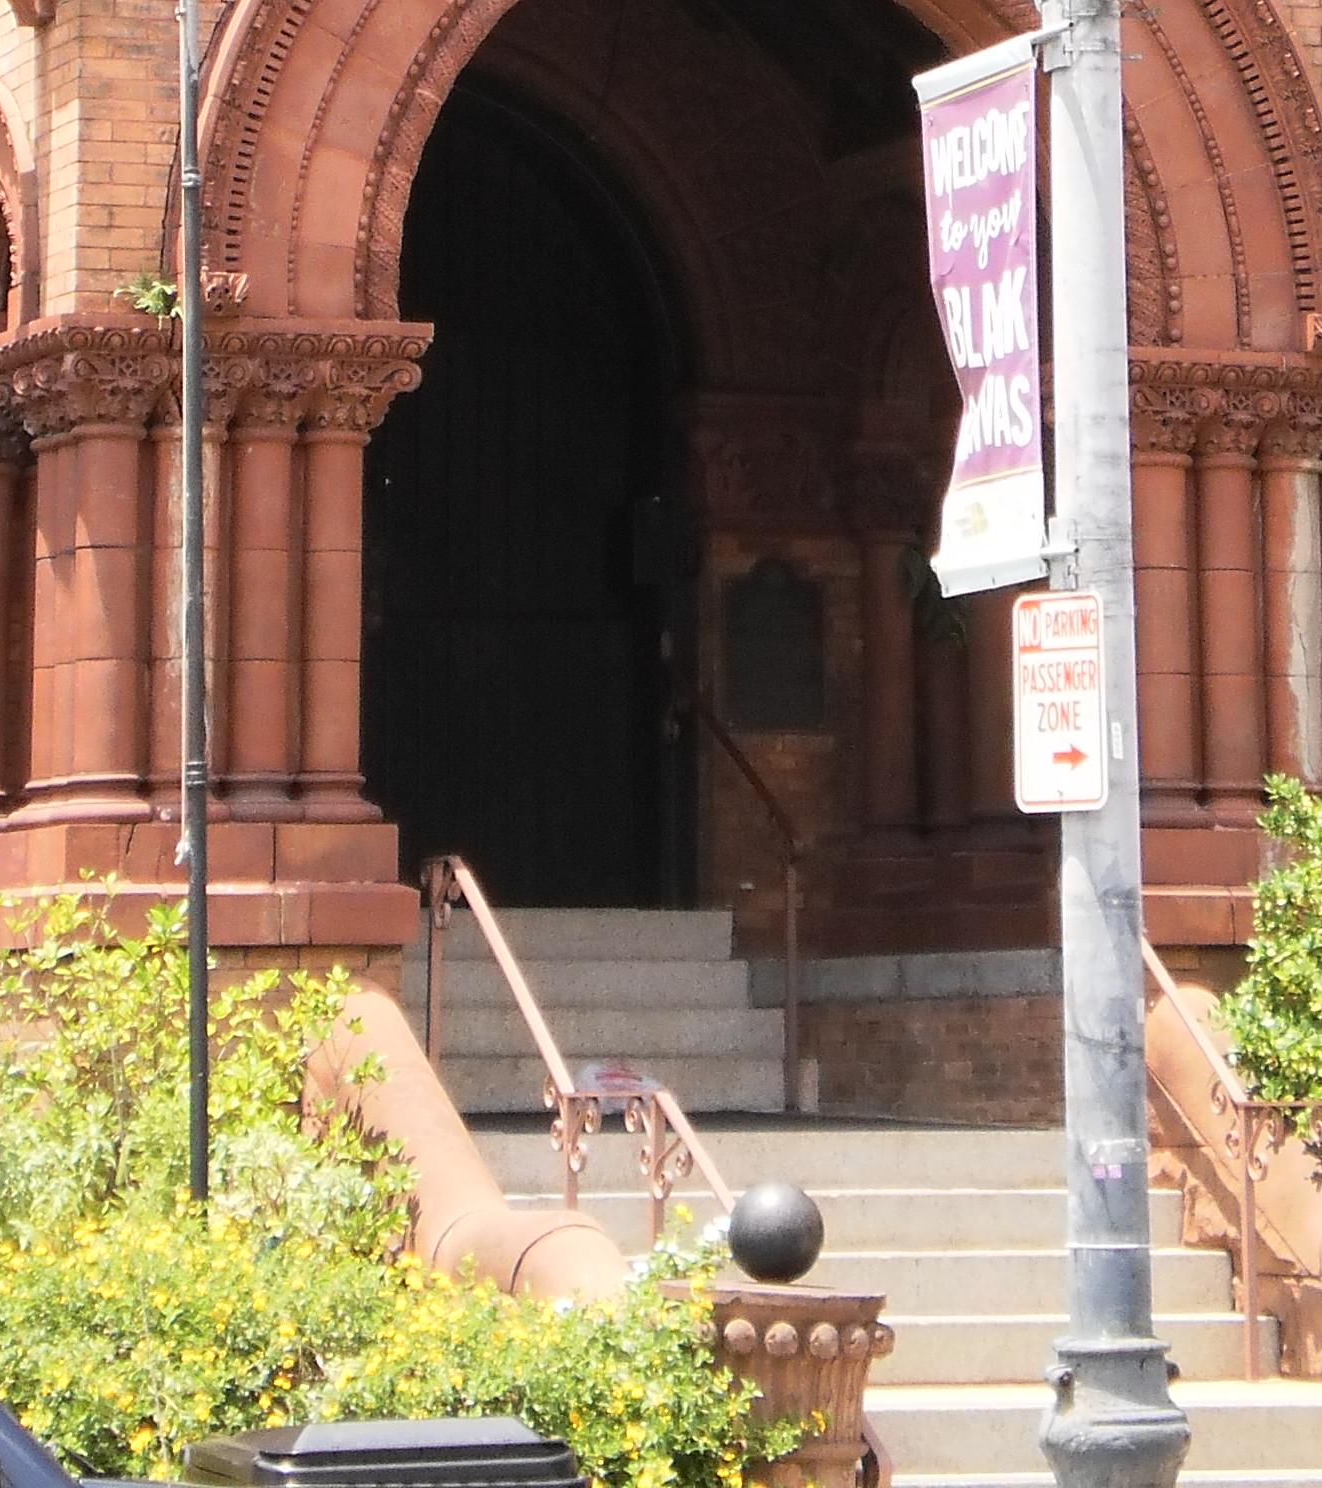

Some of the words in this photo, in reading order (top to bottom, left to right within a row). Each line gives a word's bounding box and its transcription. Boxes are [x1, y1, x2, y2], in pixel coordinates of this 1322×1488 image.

[930, 100, 1030, 197] WELCOME
[940, 209, 968, 253] to
[1020, 605, 1041, 648] NO
[1045, 608, 1098, 639] PARKING
[1022, 659, 1097, 695] PASSENGER
[1037, 701, 1082, 733] ZONE
